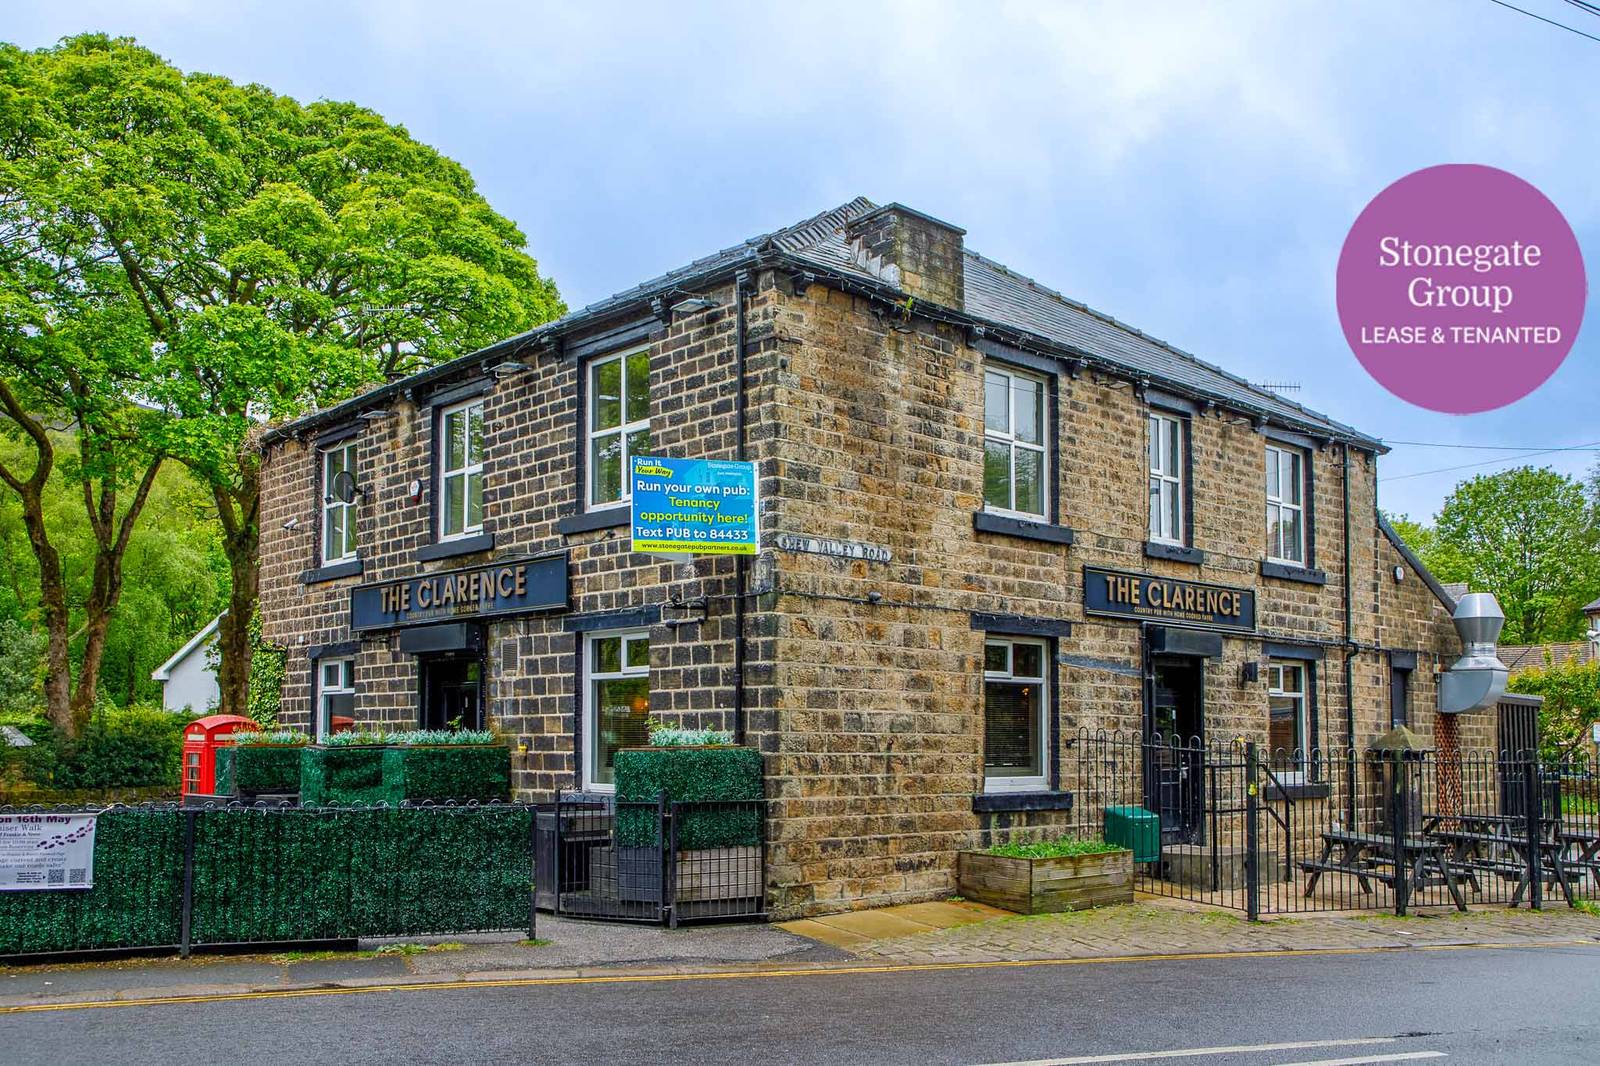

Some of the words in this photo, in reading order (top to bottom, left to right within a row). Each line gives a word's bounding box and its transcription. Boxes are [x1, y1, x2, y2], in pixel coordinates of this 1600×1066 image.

[637, 458, 653, 466] Run
[638, 466, 654, 474] Your
[656, 468, 671, 477] Way
[637, 480, 661, 491] Run
[664, 484, 691, 495] your
[694, 486, 720, 494] own
[723, 485, 750, 497] pub:
[669, 496, 720, 510] Tenancy
[640, 512, 714, 525] opportunity
[717, 512, 748, 524] here!
[636, 527, 663, 538] Text
[666, 528, 690, 538] PUB
[694, 529, 707, 539] to
[710, 530, 748, 540] 84433
[642, 543, 748, 552] www.stonegatepubpartners.co.uk
[818, 538, 855, 557] VALLEY
[863, 545, 888, 561] ROAD
[380, 584, 410, 614] THE
[416, 566, 526, 608] CLARENCE
[1106, 575, 1141, 605] THE
[1147, 582, 1241, 616] CLARENCE
[1134, 606, 1153, 614] COUNTRY
[1154, 608, 1162, 616] PUB
[1174, 610, 1185, 618] HOME
[1186, 612, 1201, 620] COOKED
[46, 816, 71, 824] May
